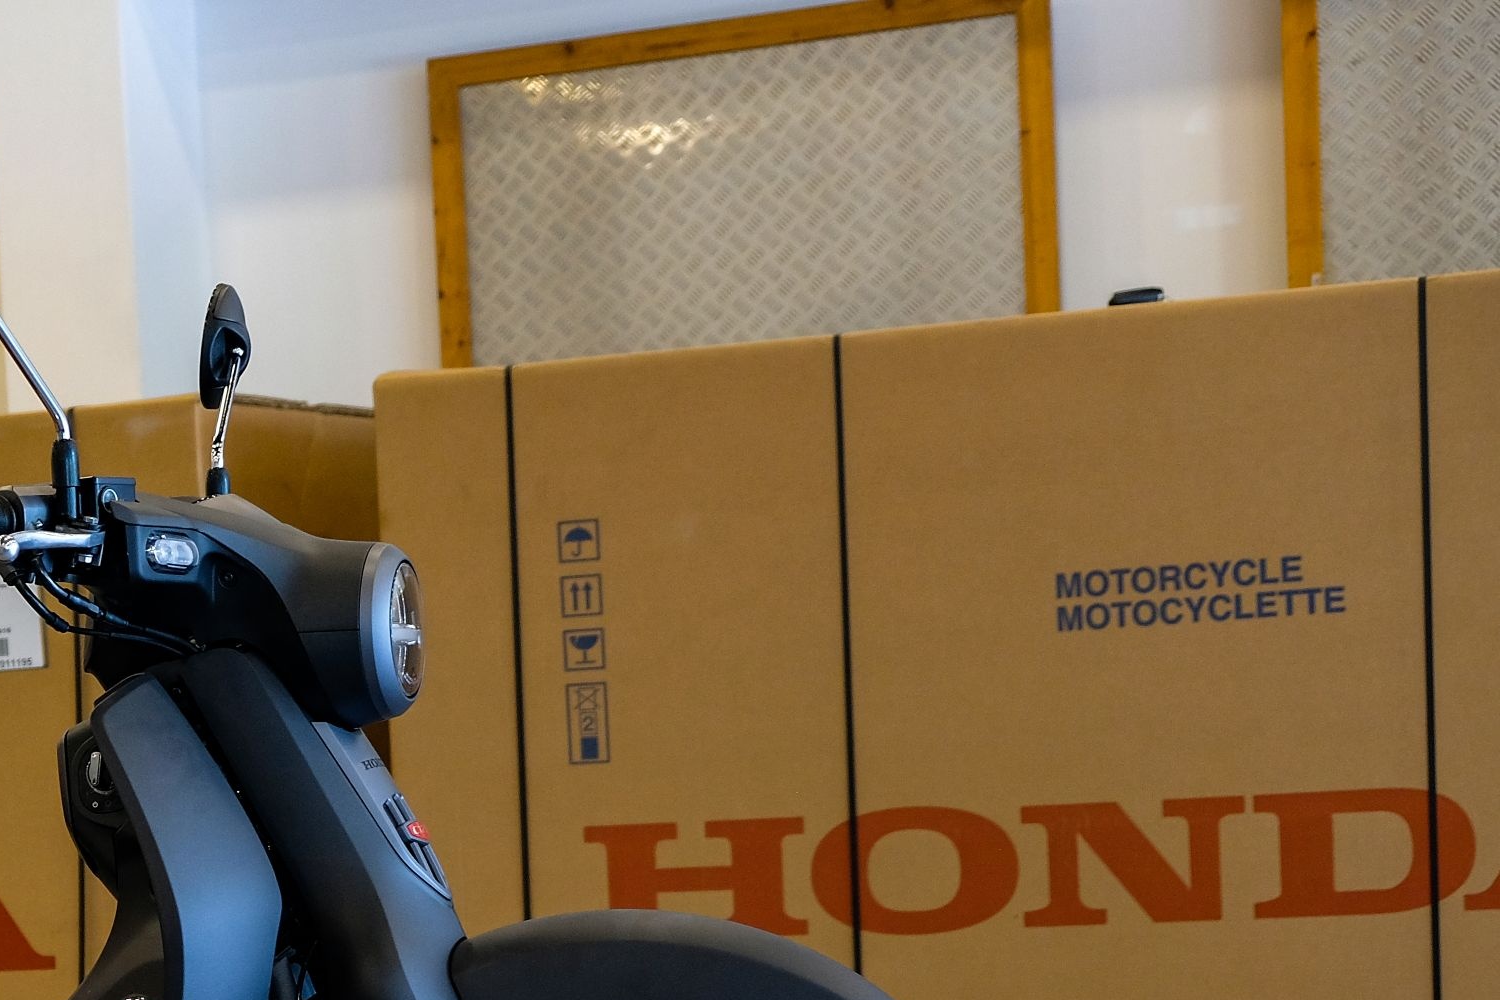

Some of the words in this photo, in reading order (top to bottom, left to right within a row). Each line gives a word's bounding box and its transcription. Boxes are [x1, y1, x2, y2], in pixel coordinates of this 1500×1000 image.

[1056, 555, 1304, 600] MOTORCYCLE
[1057, 586, 1346, 632] MOTOCYCLETTE
[583, 787, 1500, 936] HOND
